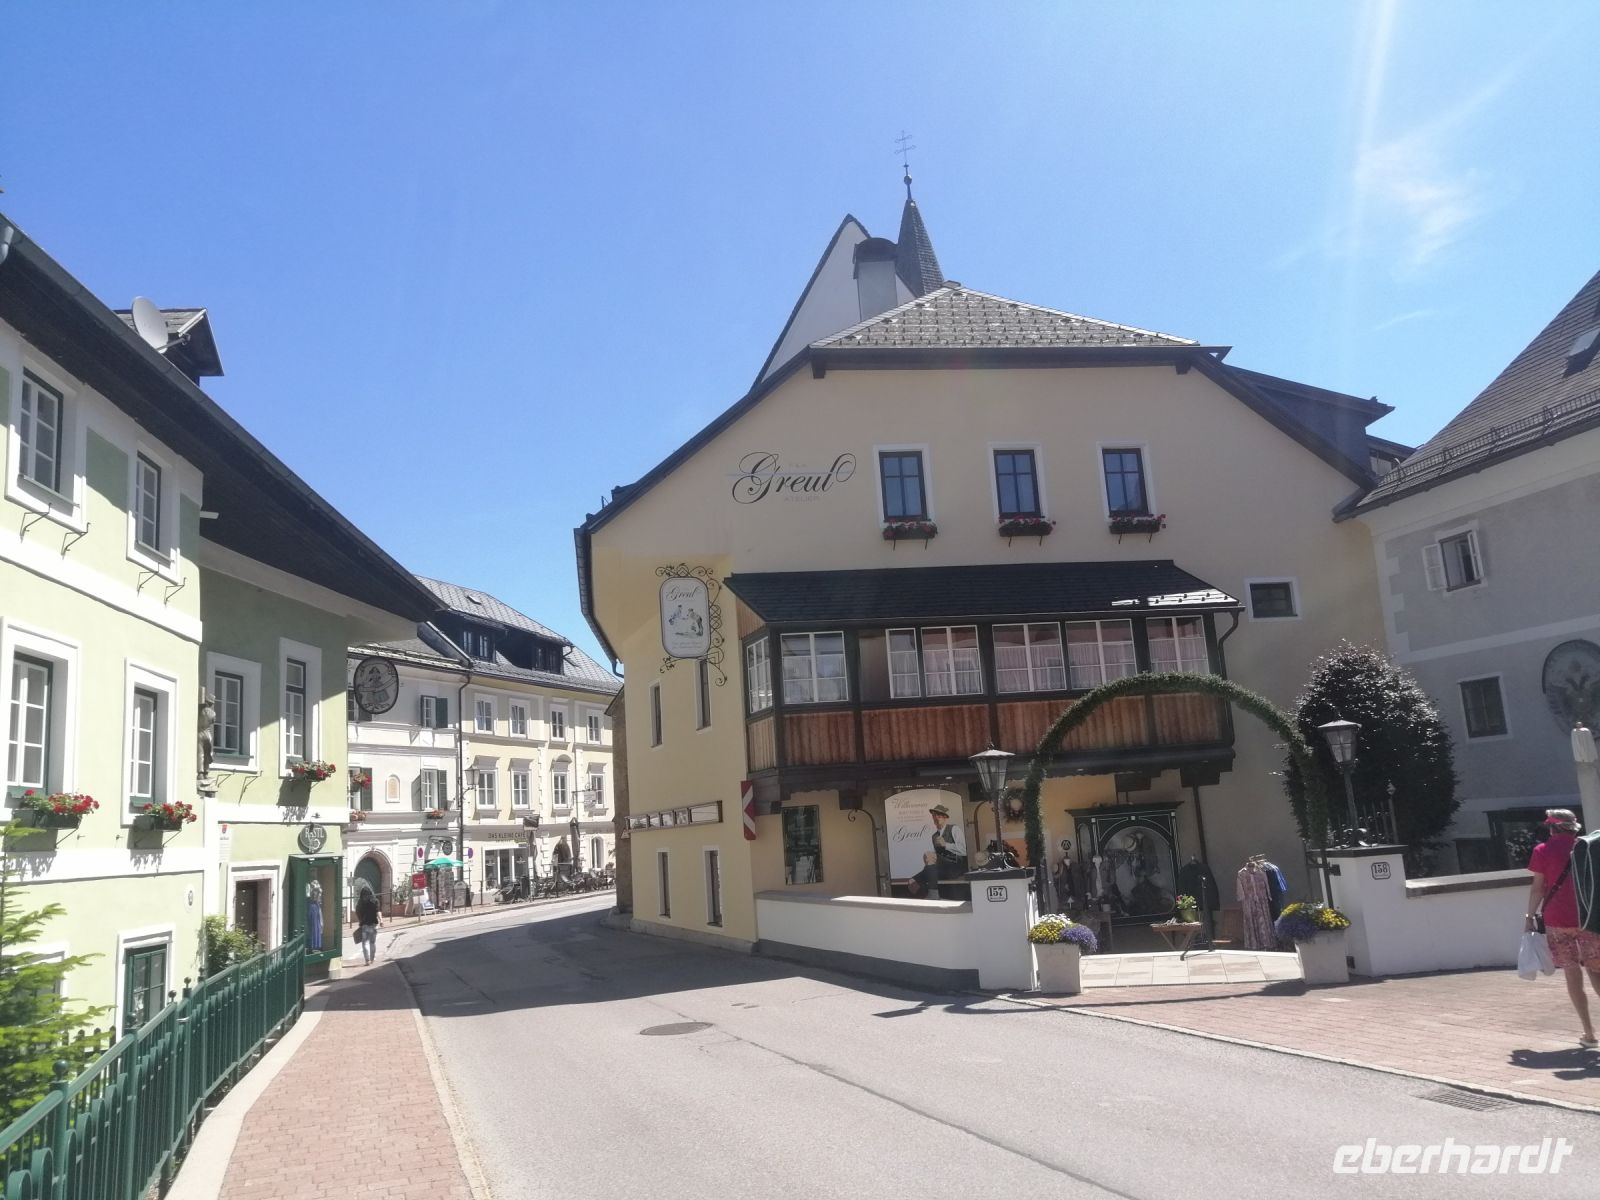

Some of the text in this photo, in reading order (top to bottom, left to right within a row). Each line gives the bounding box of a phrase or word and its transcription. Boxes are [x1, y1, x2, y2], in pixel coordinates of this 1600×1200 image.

[732, 452, 857, 504] Greul
[1374, 864, 1388, 874] 158
[989, 887, 1004, 897] 157
